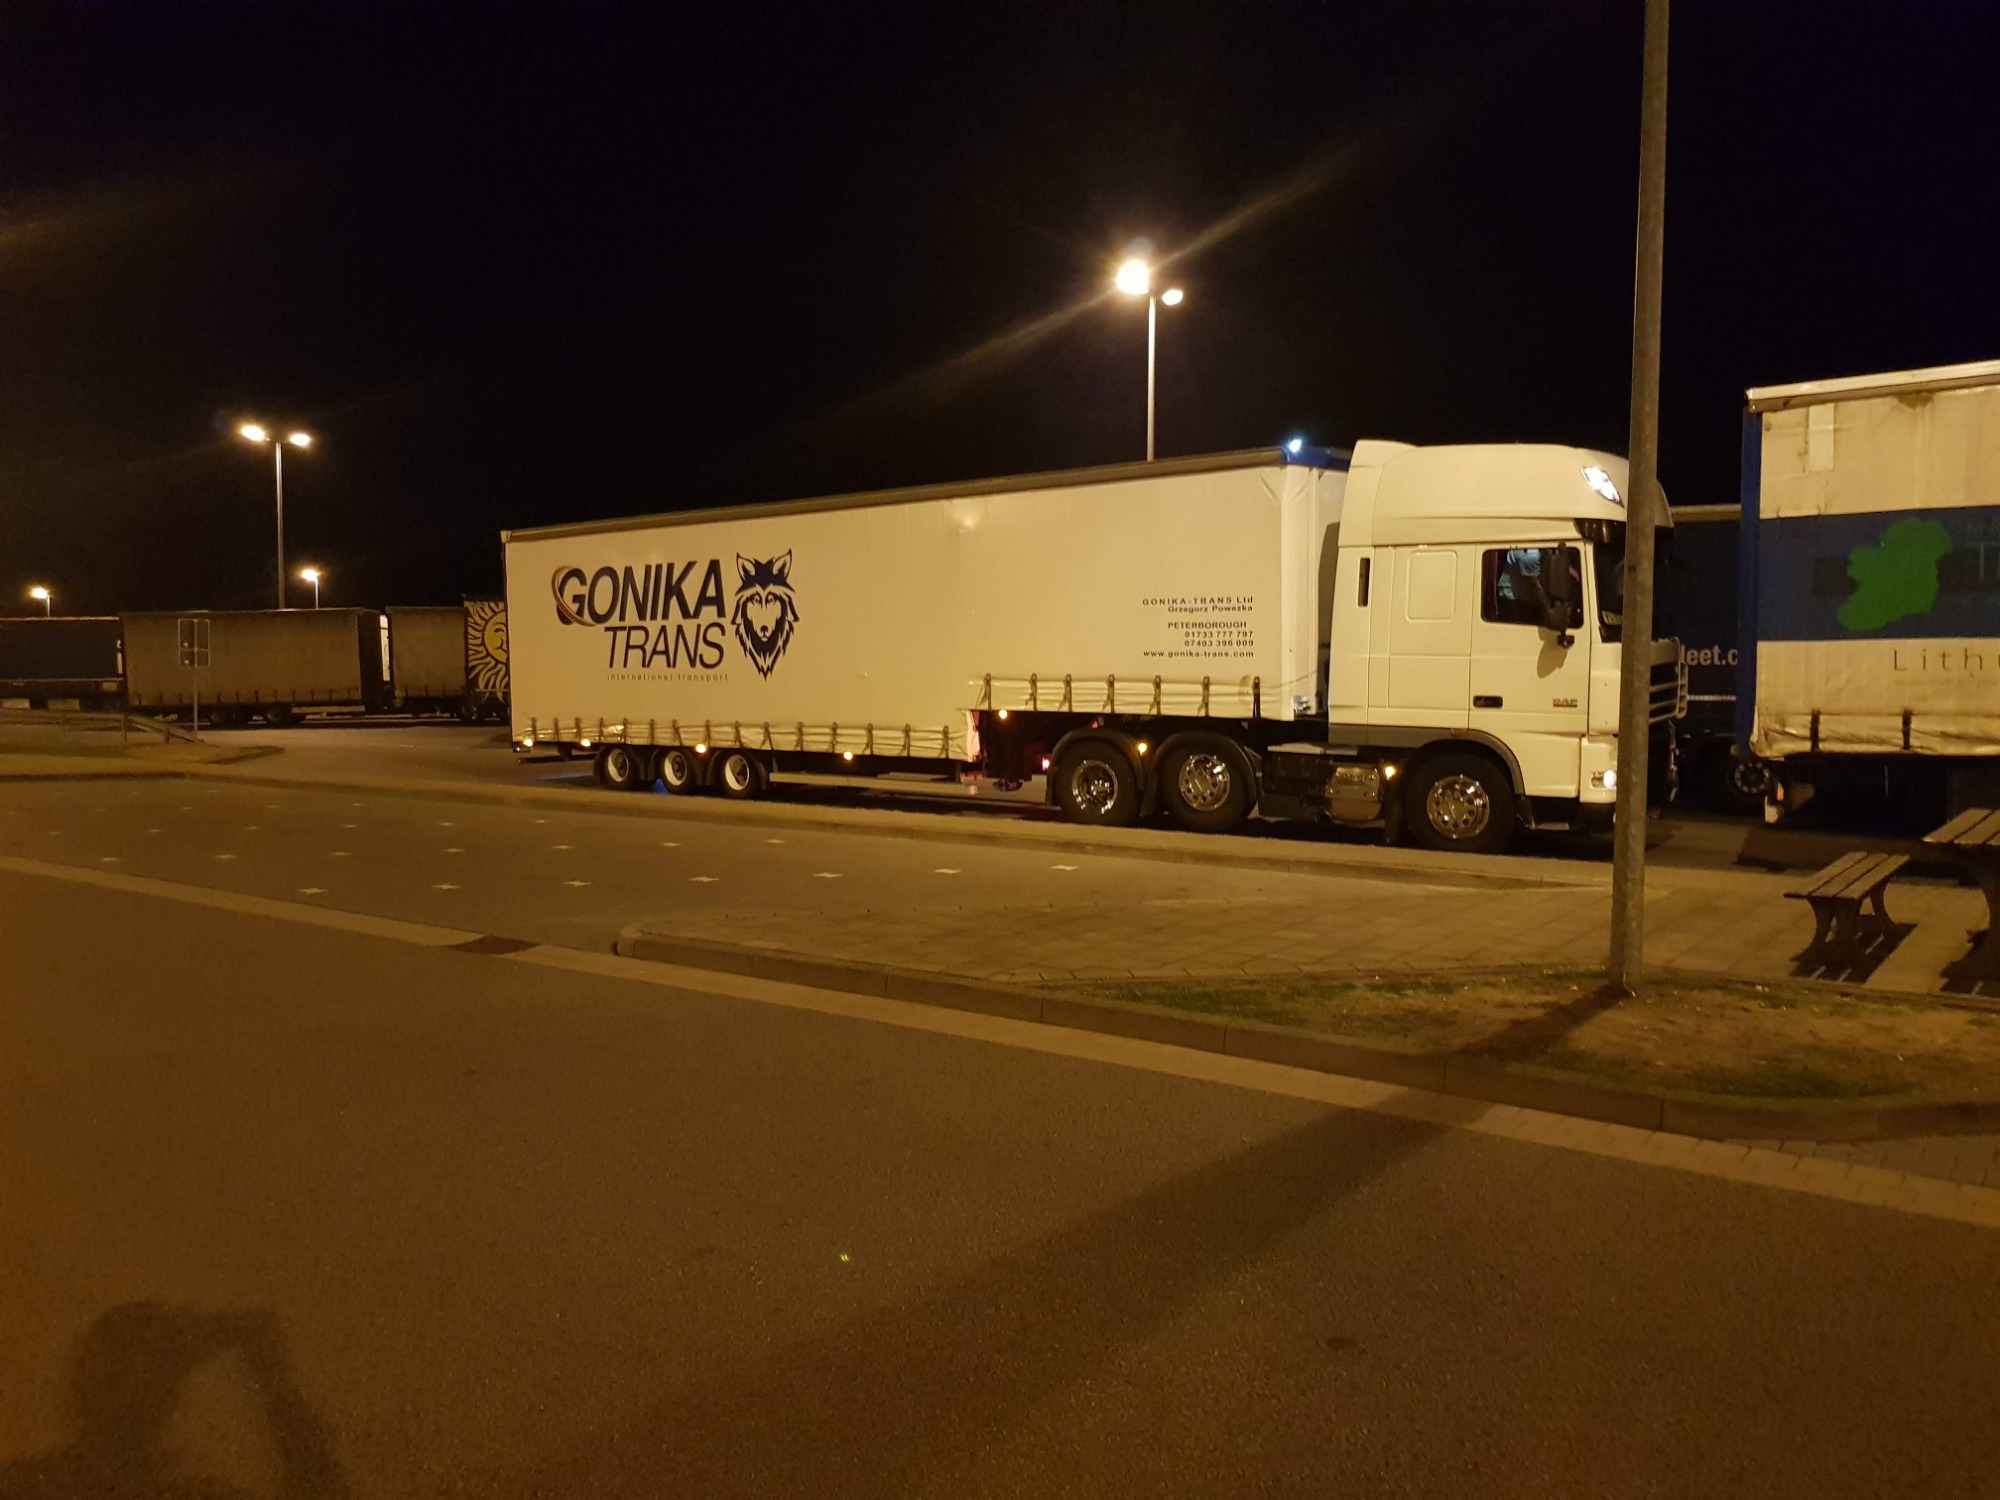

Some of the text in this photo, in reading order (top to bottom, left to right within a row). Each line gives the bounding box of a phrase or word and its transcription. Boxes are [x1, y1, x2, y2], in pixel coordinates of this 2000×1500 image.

[554, 558, 726, 626] GONIKA
[1142, 596, 1253, 606] GONIKA-TRANS Ltd
[1168, 605, 1208, 614] Grzegorz
[1168, 621, 1247, 629] PETERBOROUGH
[1236, 630, 1253, 638] 797
[604, 622, 726, 669] TRANS
[1893, 646, 2000, 671] Lith
[607, 673, 729, 683] international transport
